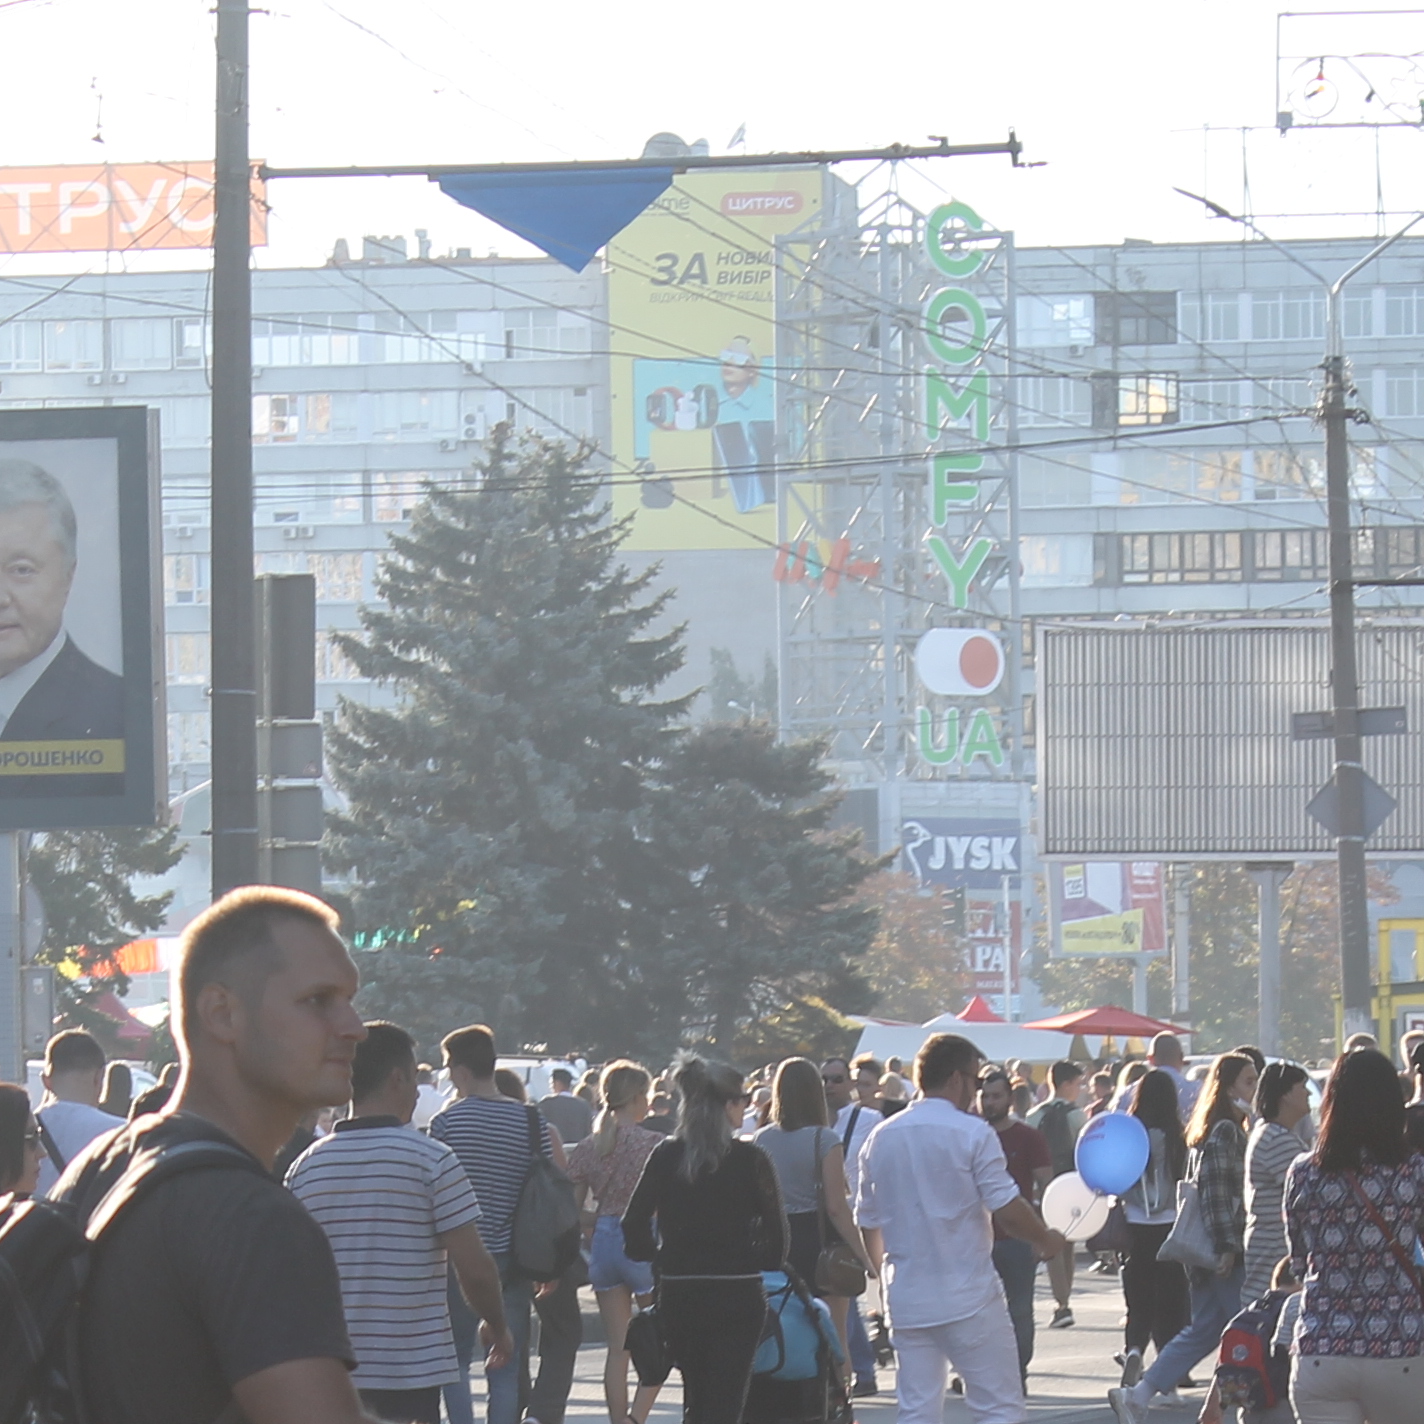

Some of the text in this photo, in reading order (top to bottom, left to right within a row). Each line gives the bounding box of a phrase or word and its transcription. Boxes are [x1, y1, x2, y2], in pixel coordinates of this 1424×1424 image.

[728, 196, 795, 211] ЦИТРУС
[650, 252, 708, 287] ЗА
[717, 270, 772, 285] ВИБІР
[925, 201, 994, 608] COMFY
[915, 707, 1004, 767] UA
[928, 836, 1018, 871] JYSK
